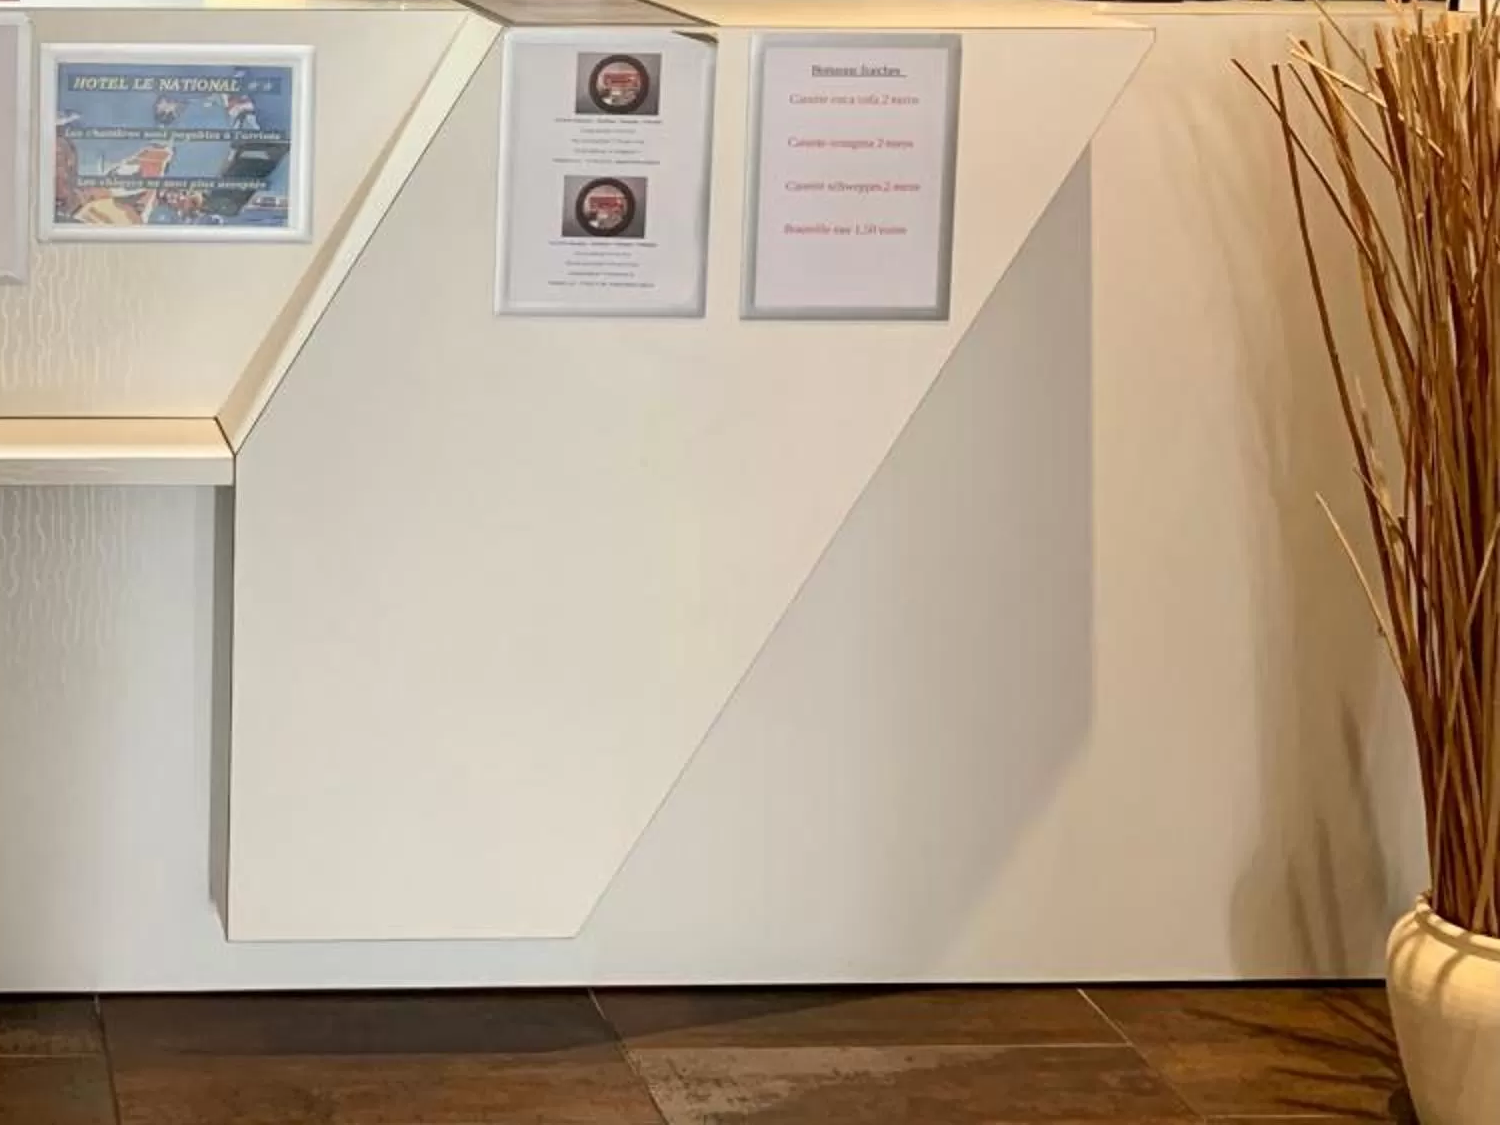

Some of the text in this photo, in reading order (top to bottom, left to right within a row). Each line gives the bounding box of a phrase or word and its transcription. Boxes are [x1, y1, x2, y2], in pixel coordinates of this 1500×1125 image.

[73, 75, 241, 92] HOTEL LE NATIONAL
